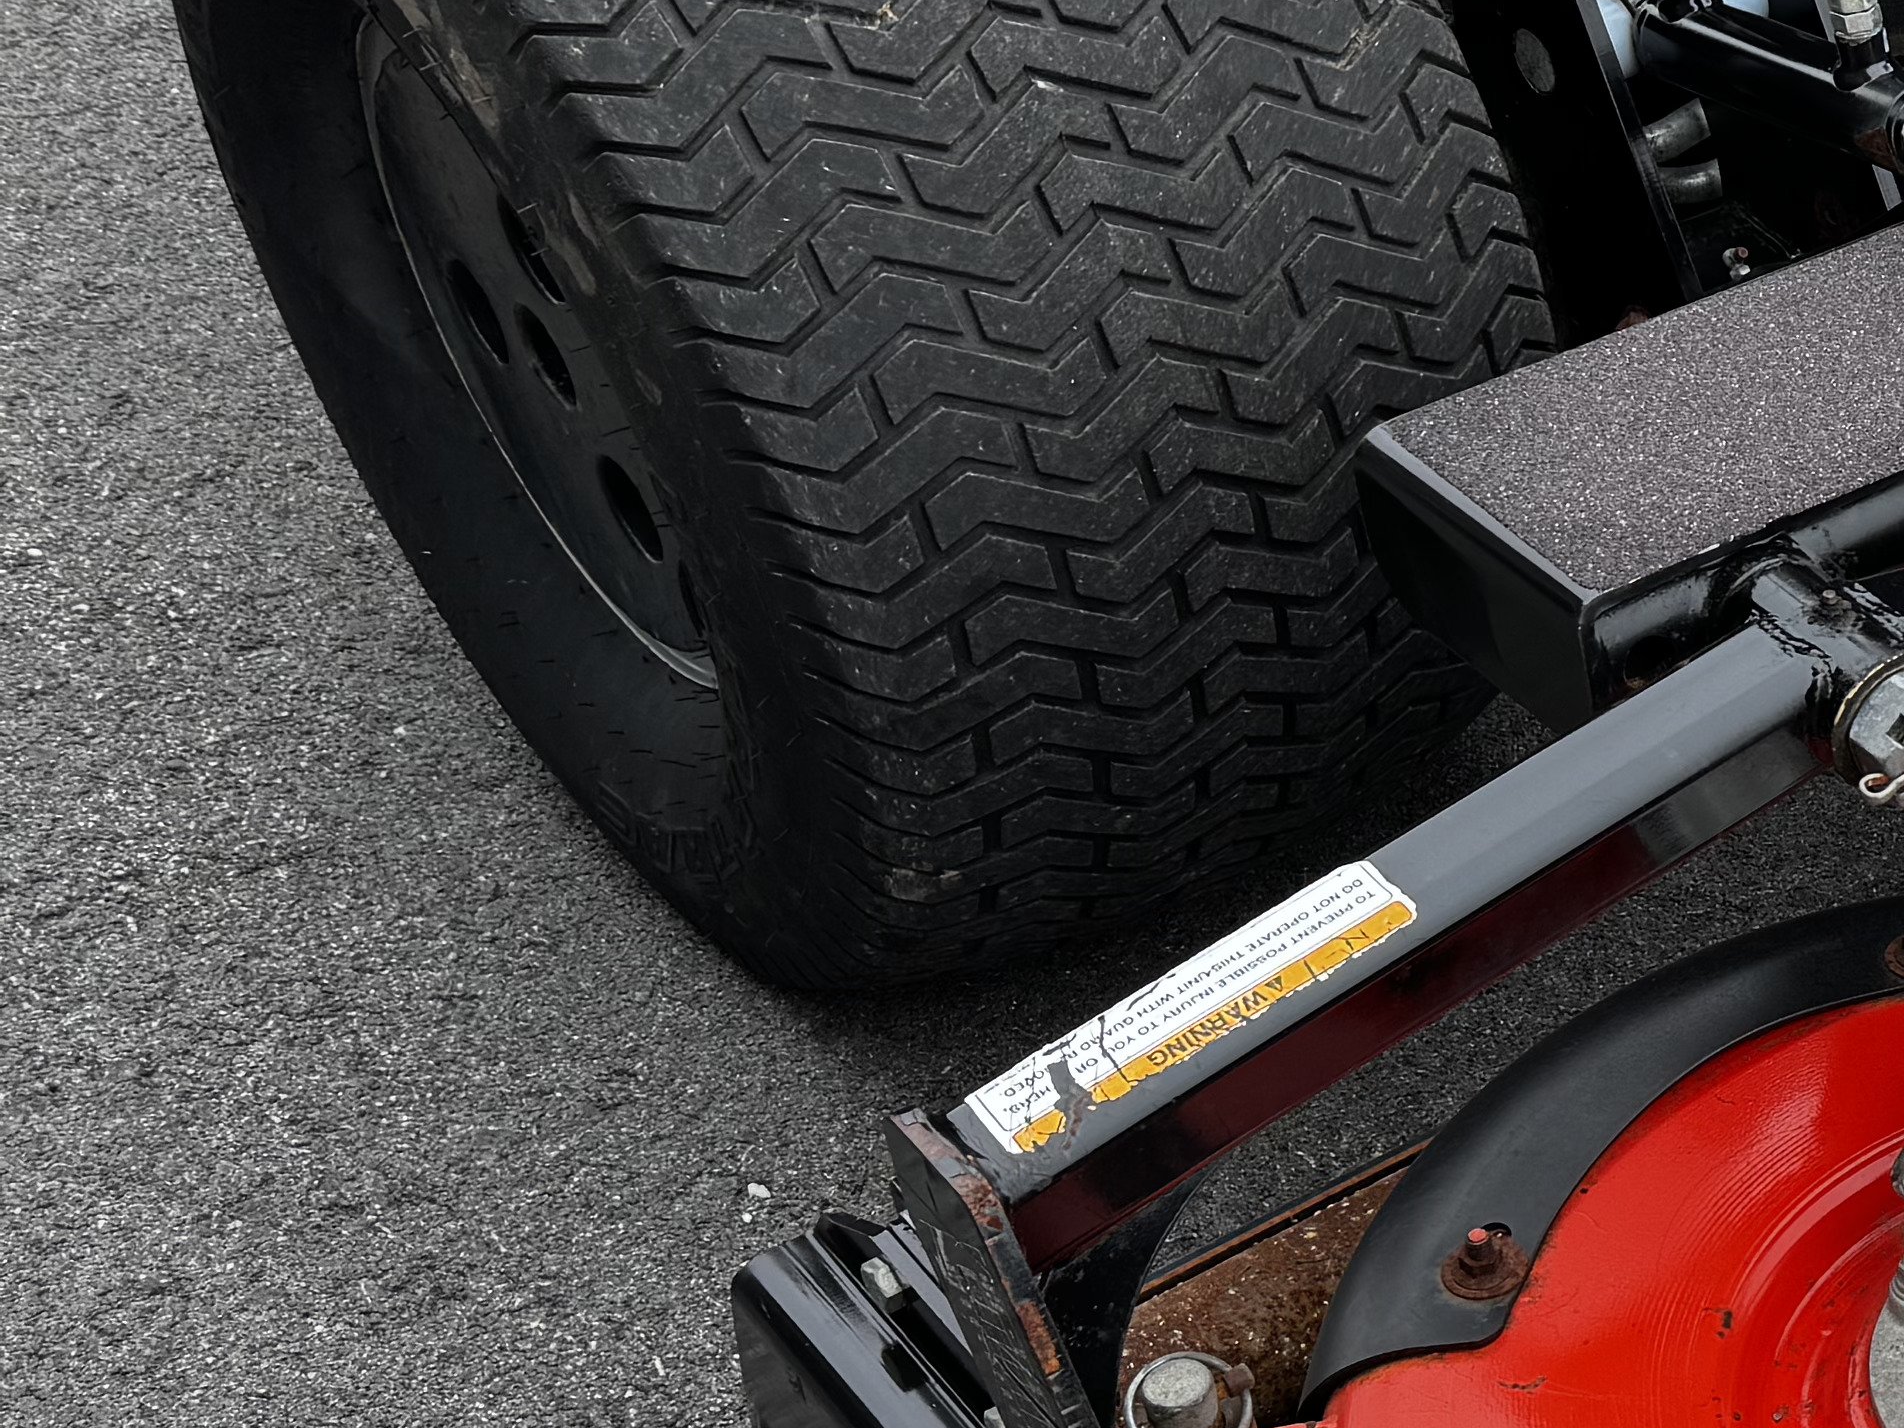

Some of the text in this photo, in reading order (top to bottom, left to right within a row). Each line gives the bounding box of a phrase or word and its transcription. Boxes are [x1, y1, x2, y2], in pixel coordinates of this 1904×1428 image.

[1342, 879, 1363, 893] DO
[1355, 891, 1375, 903] TO
[1313, 893, 1340, 912] NOT
[1245, 912, 1309, 951] OPERATE
[1291, 903, 1353, 944] PREVENT
[1216, 943, 1287, 987] POSSIBLE
[1137, 994, 1174, 1017] WITH
[1164, 987, 1214, 1022] INJURY
[1138, 1022, 1158, 1035] TO
[1146, 989, 1270, 1067] WARNING
